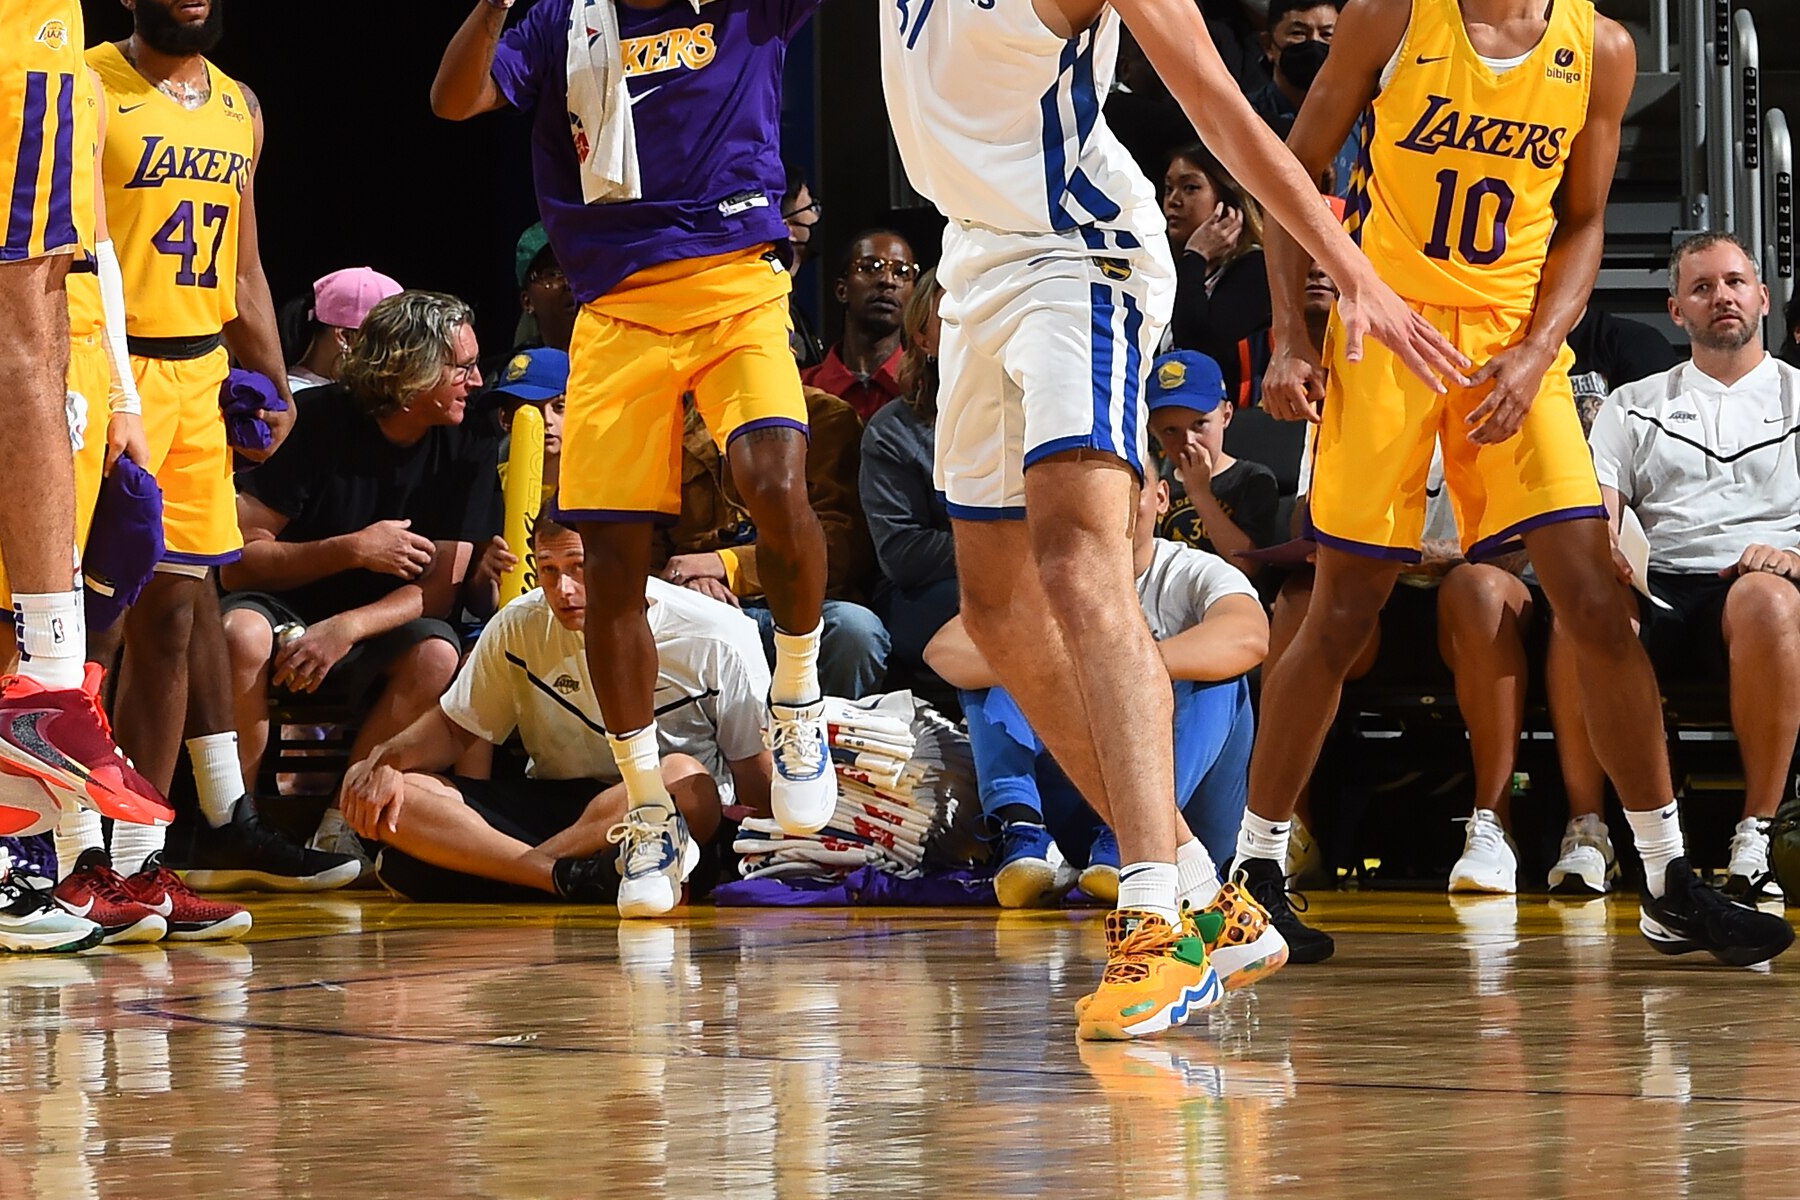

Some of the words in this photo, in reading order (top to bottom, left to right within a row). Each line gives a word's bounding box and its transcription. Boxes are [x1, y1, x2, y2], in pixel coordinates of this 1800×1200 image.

[618, 22, 718, 78] KERS
[1546, 66, 1581, 84] bibigo
[124, 135, 252, 196] LAKERS
[1395, 94, 1567, 169] LAKERS
[151, 200, 230, 289] 47
[1423, 168, 1515, 265] 10
